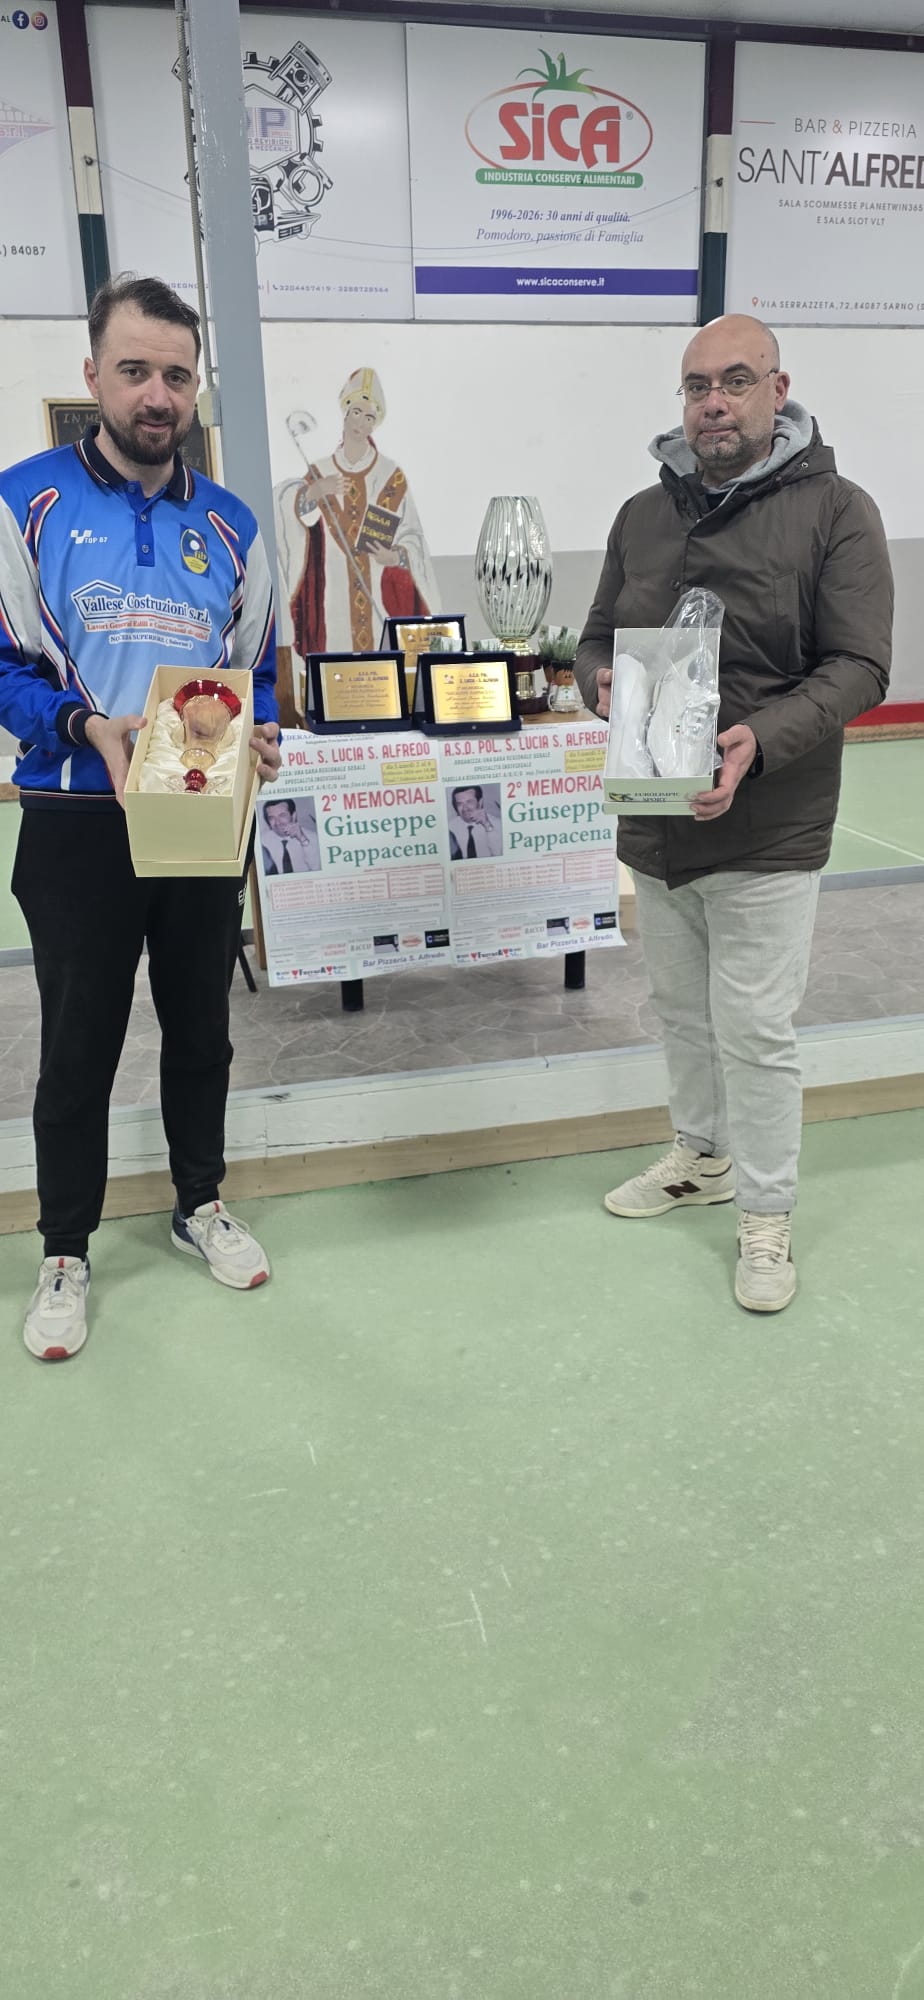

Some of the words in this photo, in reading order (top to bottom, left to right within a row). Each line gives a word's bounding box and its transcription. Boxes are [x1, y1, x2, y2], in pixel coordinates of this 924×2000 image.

[794, 118, 827, 134] BAR
[832, 119, 842, 134] &
[848, 121, 917, 138] PIZZERIA
[484, 172, 533, 182] INDUSTRIA
[535, 173, 582, 184] CONSERVE
[583, 175, 635, 185] ALIMENTARI
[778, 200, 801, 208] SALA
[803, 200, 857, 210] SCOMMESSE
[860, 202, 923, 212] PLANETWIN365
[490, 208, 544, 222] 1996-2026:
[546, 210, 559, 222] 30
[560, 211, 583, 222] anni
[584, 211, 594, 223] di
[816, 216, 821, 224] E
[823, 216, 846, 225] SALA
[848, 217, 868, 225] SLOT
[871, 217, 885, 226] VLT
[476, 228, 533, 242] Pomodoro,
[536, 231, 581, 244] passione
[584, 230, 595, 242] di
[597, 230, 643, 245] Famiglia
[10, 245, 46, 256] 84087
[516, 276, 605, 287] www.sicaconserve.it
[760, 300, 777, 308] VIA
[882, 302, 914, 310] SARNO
[82, 596, 124, 612] Vallese
[127, 594, 187, 616] Costruzioni
[189, 608, 211, 624] s.r.l.
[288, 752, 313, 767] POL.
[317, 750, 328, 764] S.
[332, 747, 364, 763] LUCIA
[368, 746, 378, 760] S.
[382, 742, 430, 759] ALFREDO
[444, 741, 475, 757] A.S.D.
[479, 738, 501, 754] POL.
[505, 738, 515, 752] S.
[519, 735, 549, 750] LUCIA
[553, 734, 562, 748] S.
[507, 781, 522, 799] 2°
[527, 774, 603, 797] MEMORIA
[321, 793, 337, 812] 2°
[343, 786, 435, 810] MEMORIAL
[324, 813, 437, 838] Giuseppe
[509, 828, 612, 852] Pappacena
[327, 841, 438, 867] Pappacena
[362, 959, 376, 967] Bar
